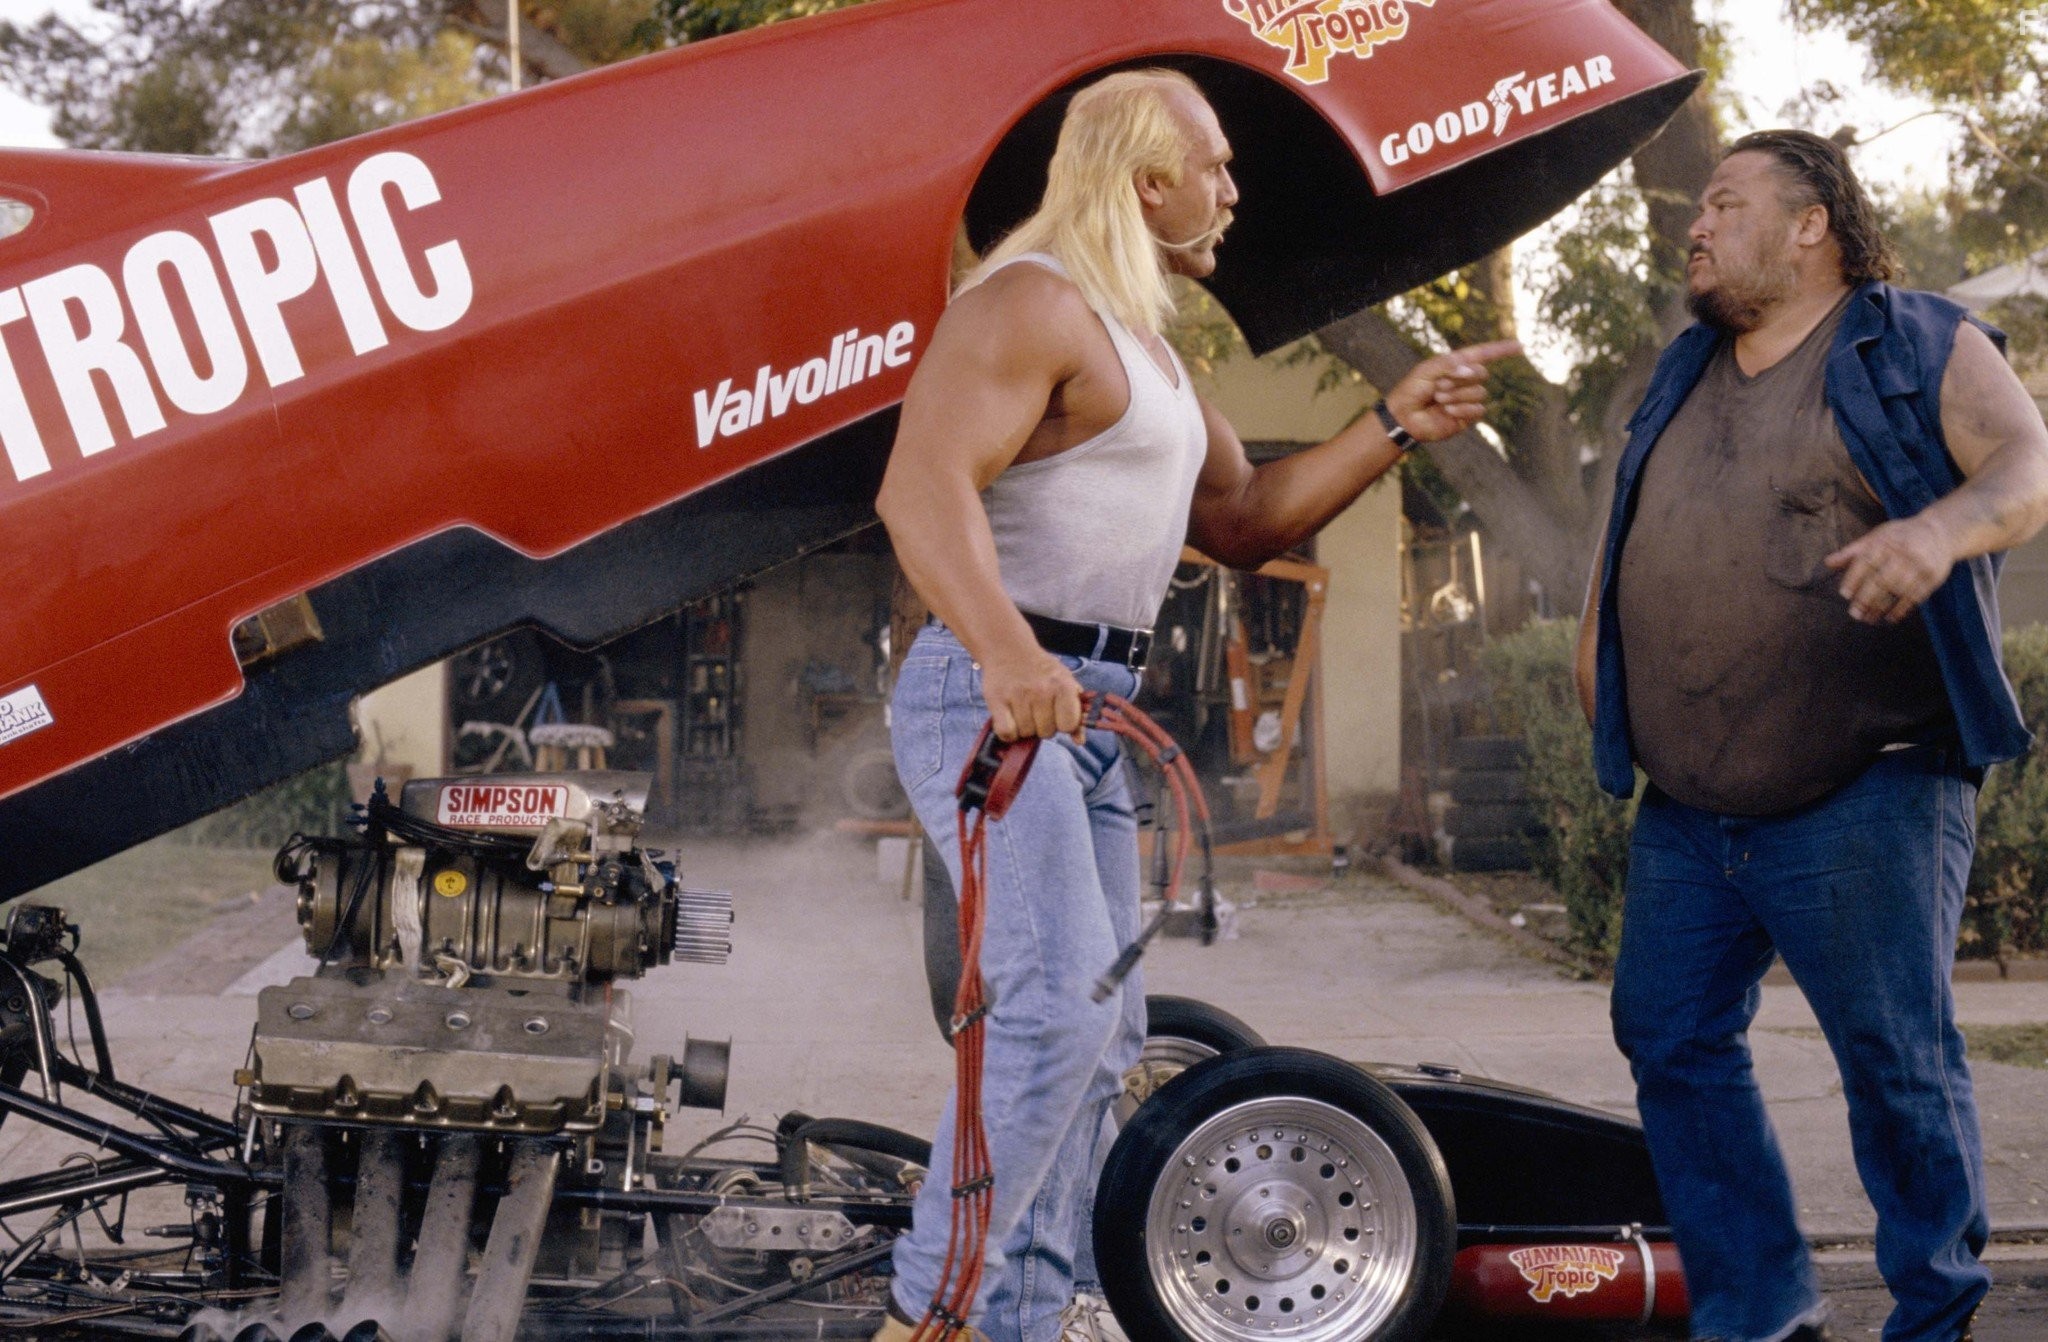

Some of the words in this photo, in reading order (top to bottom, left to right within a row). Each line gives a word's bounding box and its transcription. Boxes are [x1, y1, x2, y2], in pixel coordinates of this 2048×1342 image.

[1264, 0, 1404, 67] Tropic
[0, 151, 474, 482] TROPIC
[693, 321, 915, 449] Valvoline
[0, 702, 46, 735] ANK
[447, 787, 557, 814] SIMPSON
[449, 814, 482, 825] RACE
[1512, 1247, 1621, 1272] HAWAIIAN
[1526, 1263, 1596, 1292] Tropic
